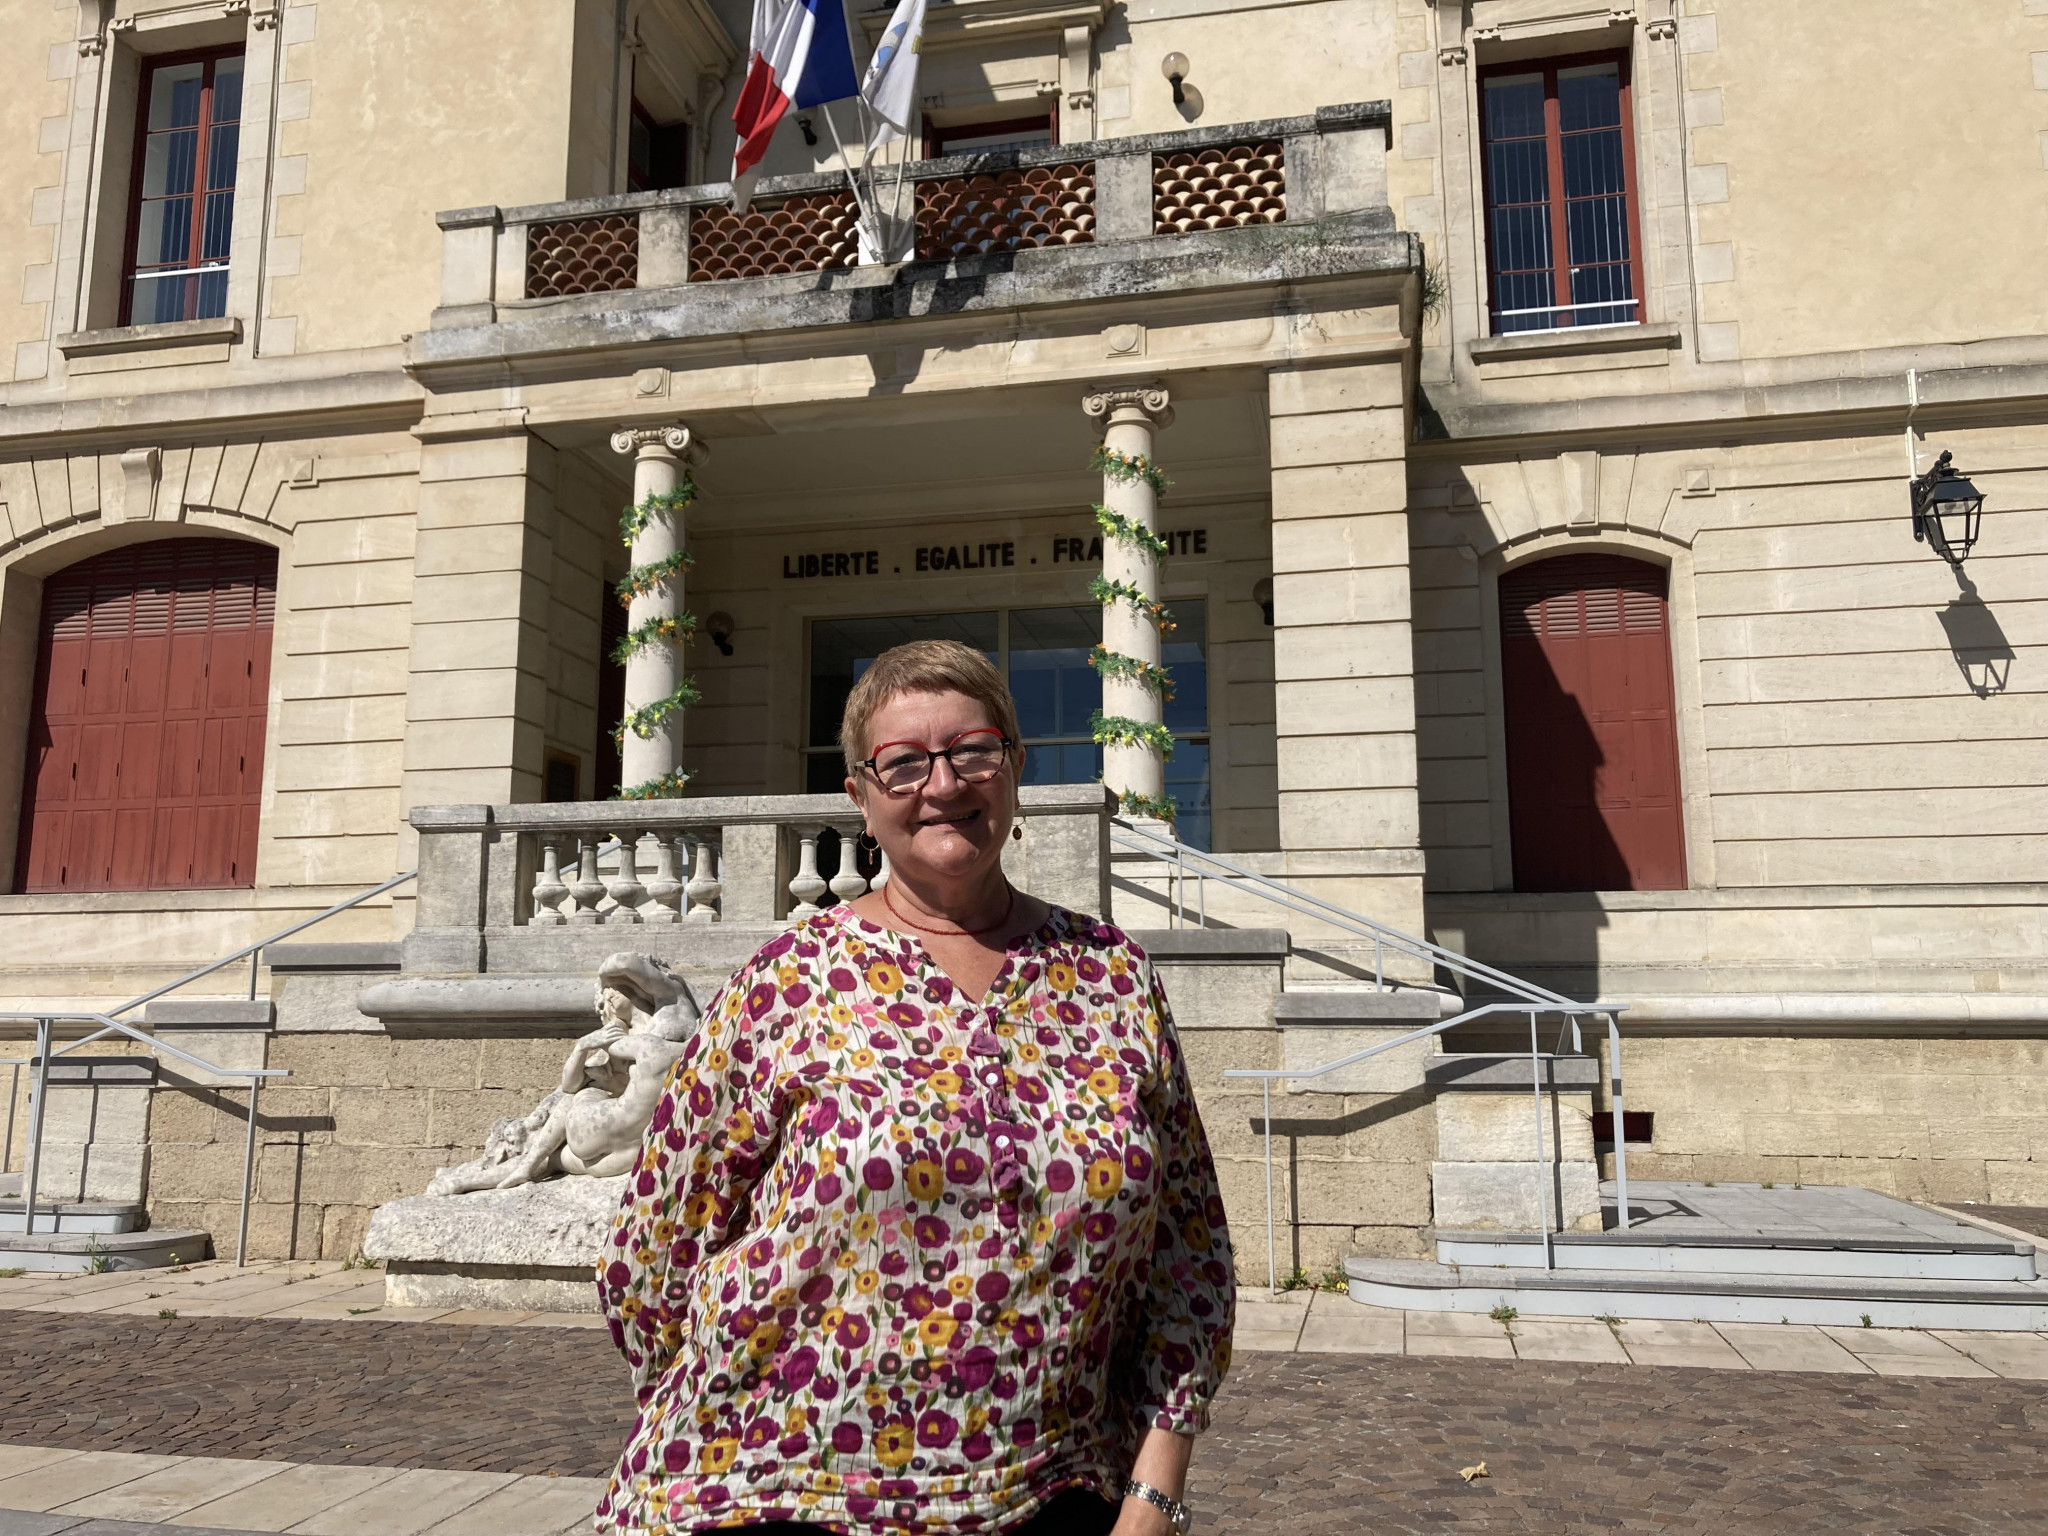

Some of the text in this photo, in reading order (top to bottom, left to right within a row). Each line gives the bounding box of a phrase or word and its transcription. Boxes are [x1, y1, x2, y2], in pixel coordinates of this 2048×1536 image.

[783, 551, 879, 579] LIBERTE
[915, 542, 1015, 571] EGALITE
[1053, 529, 1207, 563] FRAITE
